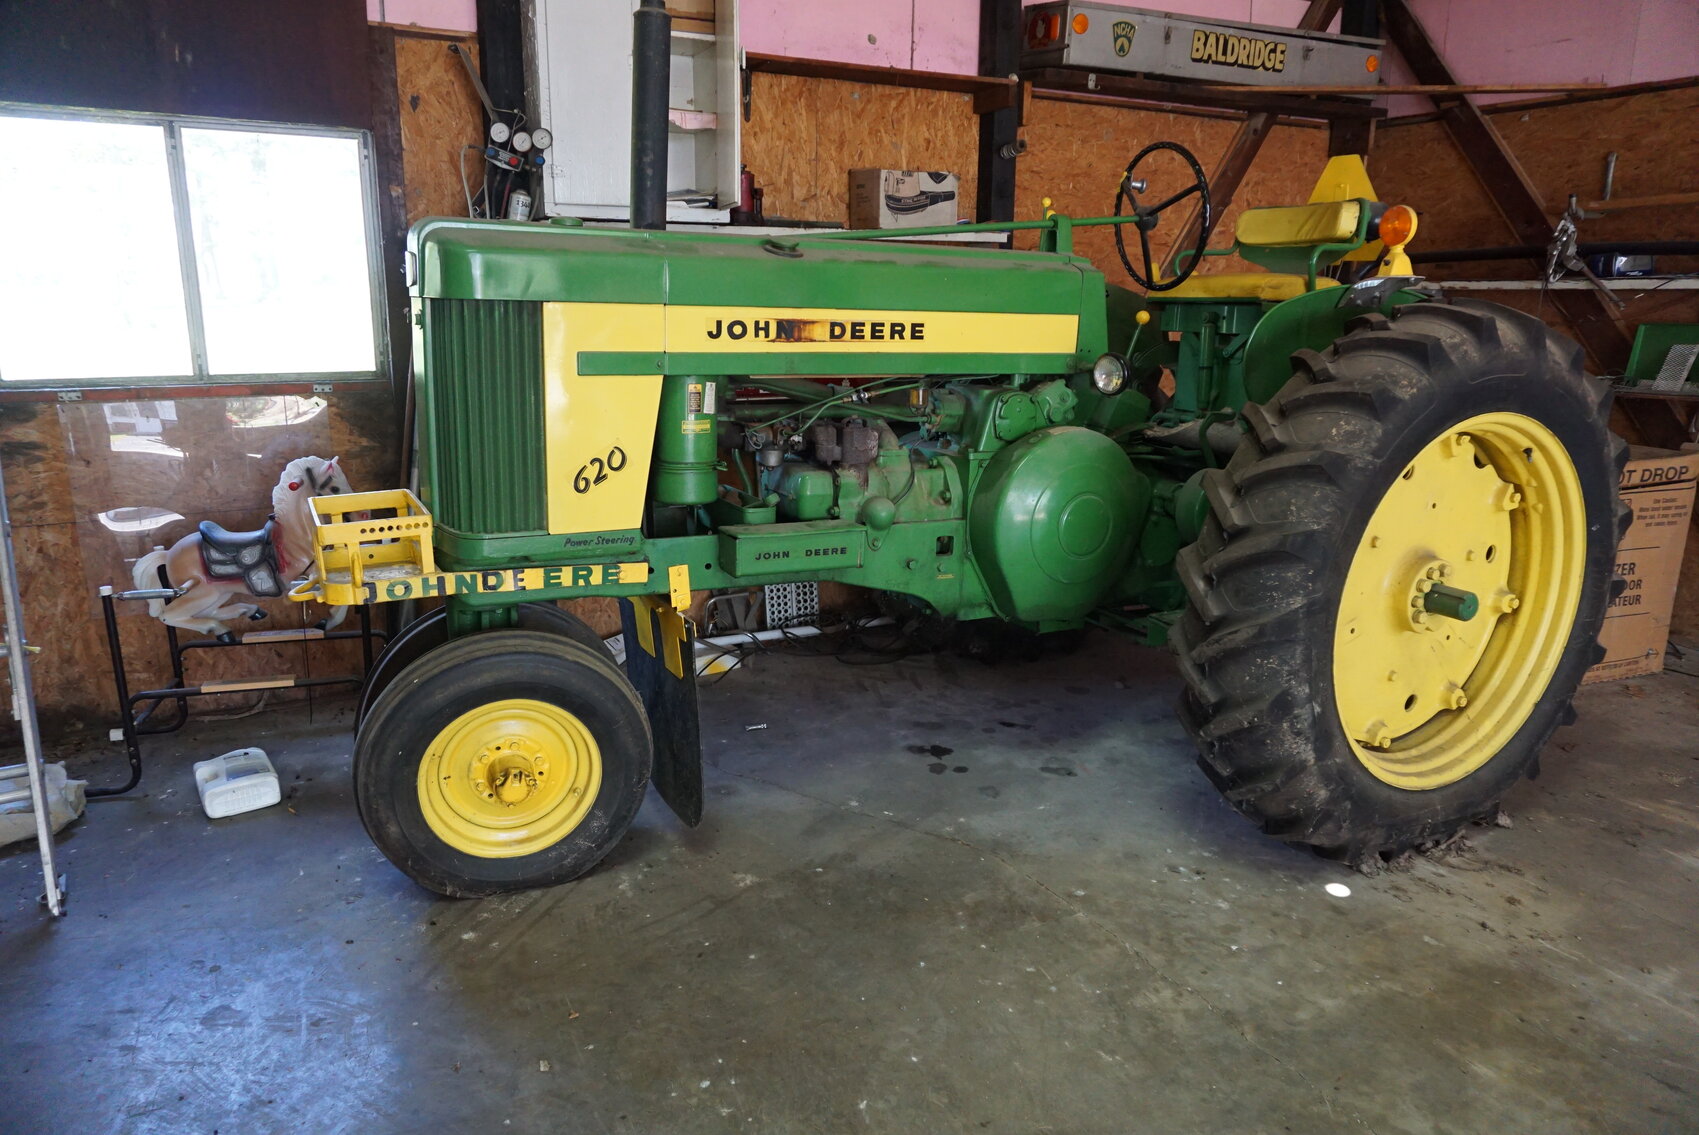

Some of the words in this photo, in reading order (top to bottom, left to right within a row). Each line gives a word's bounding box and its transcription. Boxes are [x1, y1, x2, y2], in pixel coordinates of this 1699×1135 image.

[1191, 29, 1287, 72] BALDRIDGE
[707, 320, 796, 340] JOHN
[829, 321, 925, 340] DEERE
[573, 446, 627, 494] 620
[1640, 465, 1689, 483] DROP
[563, 537, 592, 548] Power
[595, 534, 635, 546] Steering
[755, 550, 790, 561] JOHN
[805, 546, 847, 557] DEERE
